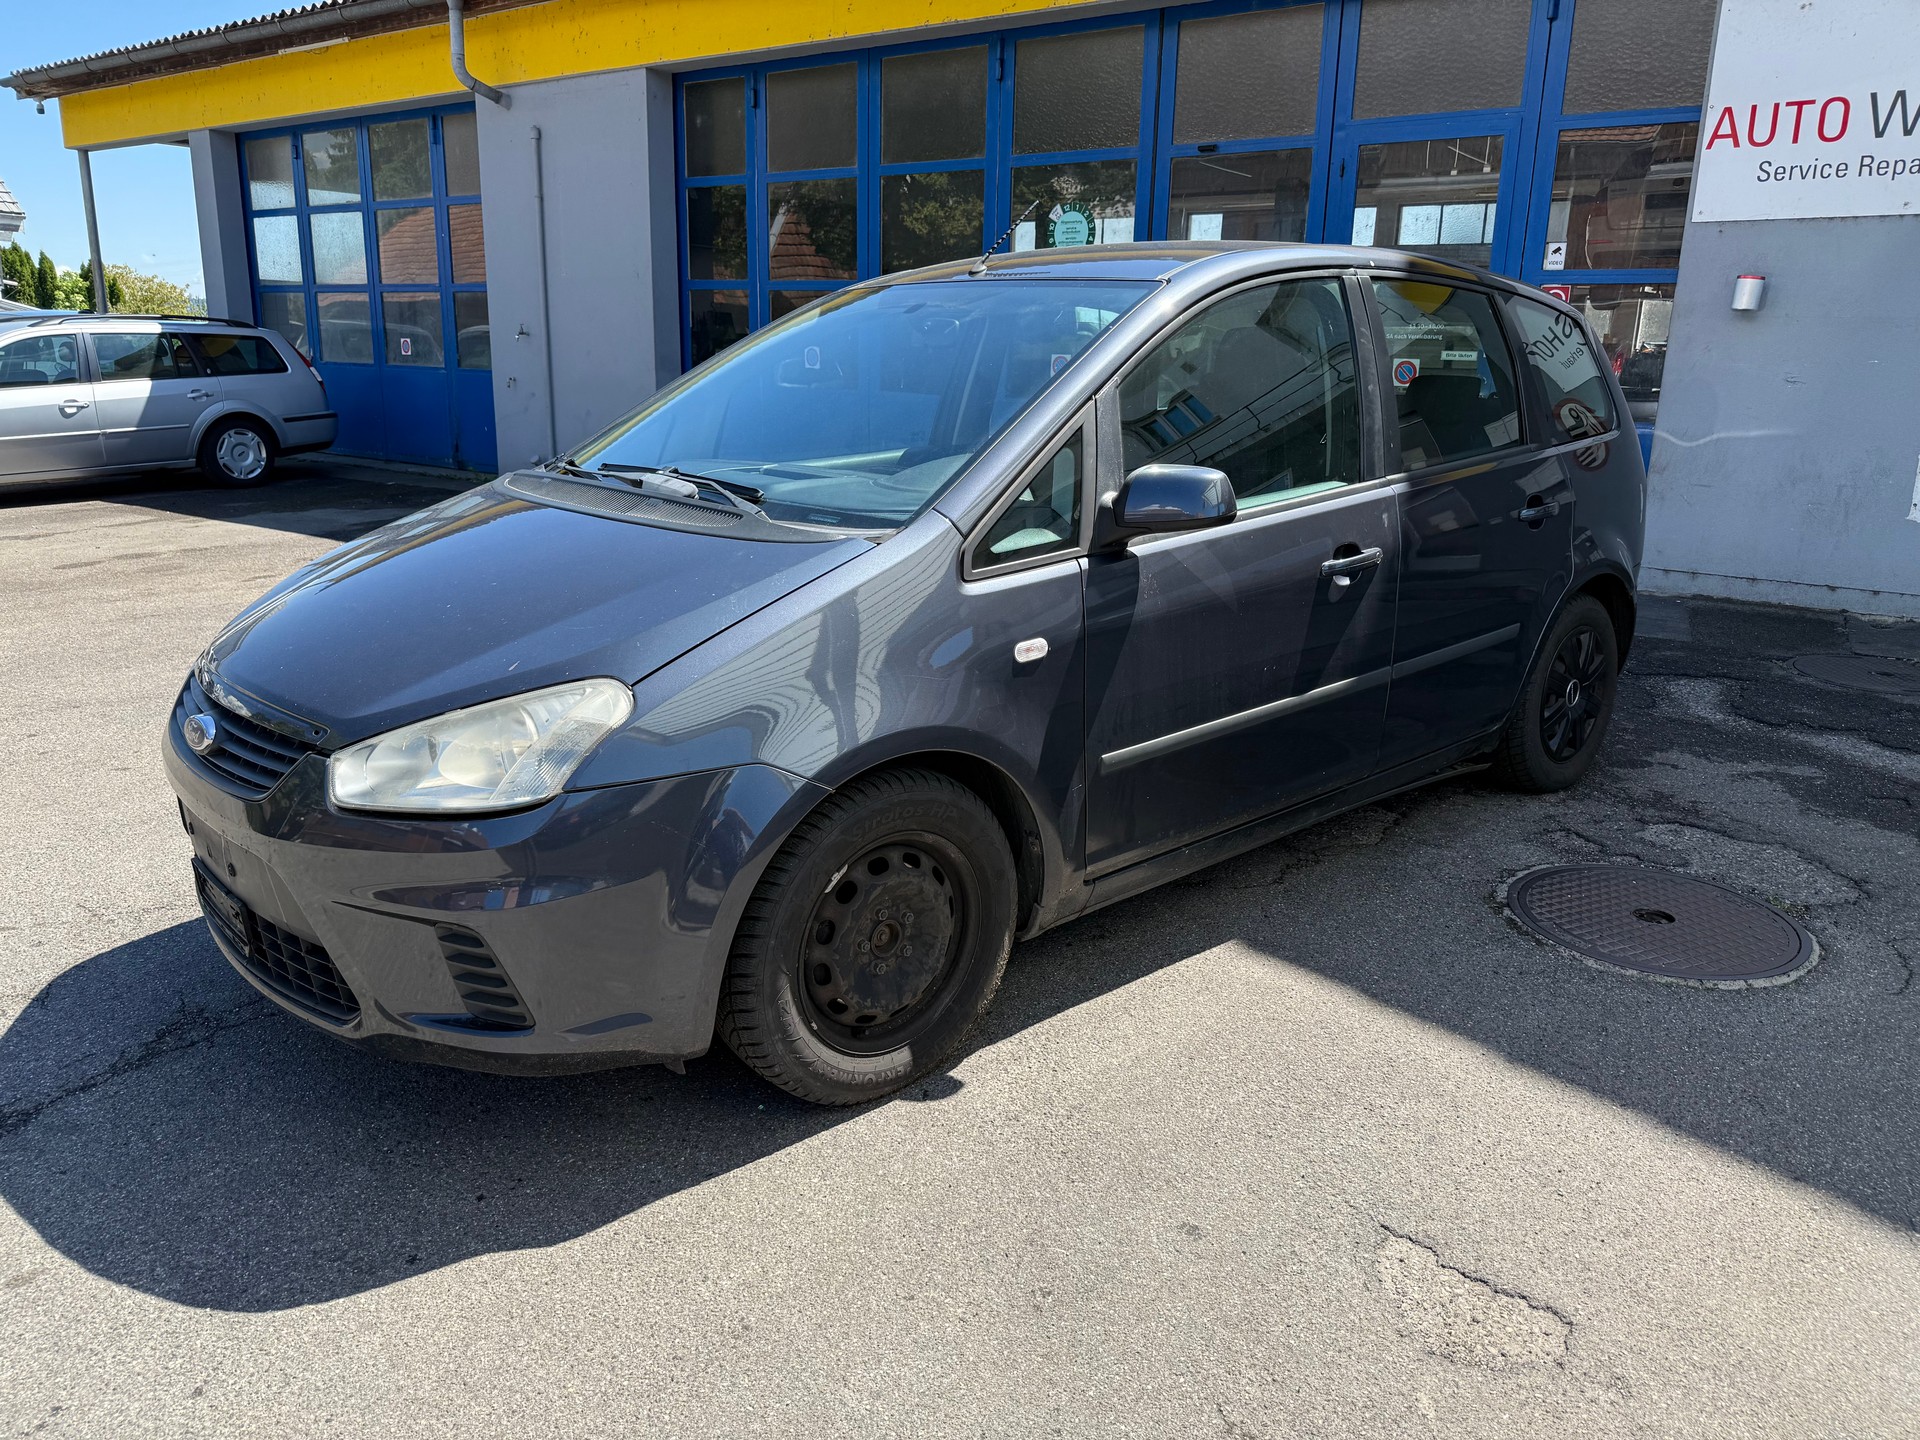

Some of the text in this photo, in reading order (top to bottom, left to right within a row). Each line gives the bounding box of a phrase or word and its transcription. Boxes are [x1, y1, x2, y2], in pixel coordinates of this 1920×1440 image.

[1706, 96, 1851, 150] AUTO
[1757, 154, 1920, 182] Service Repa
